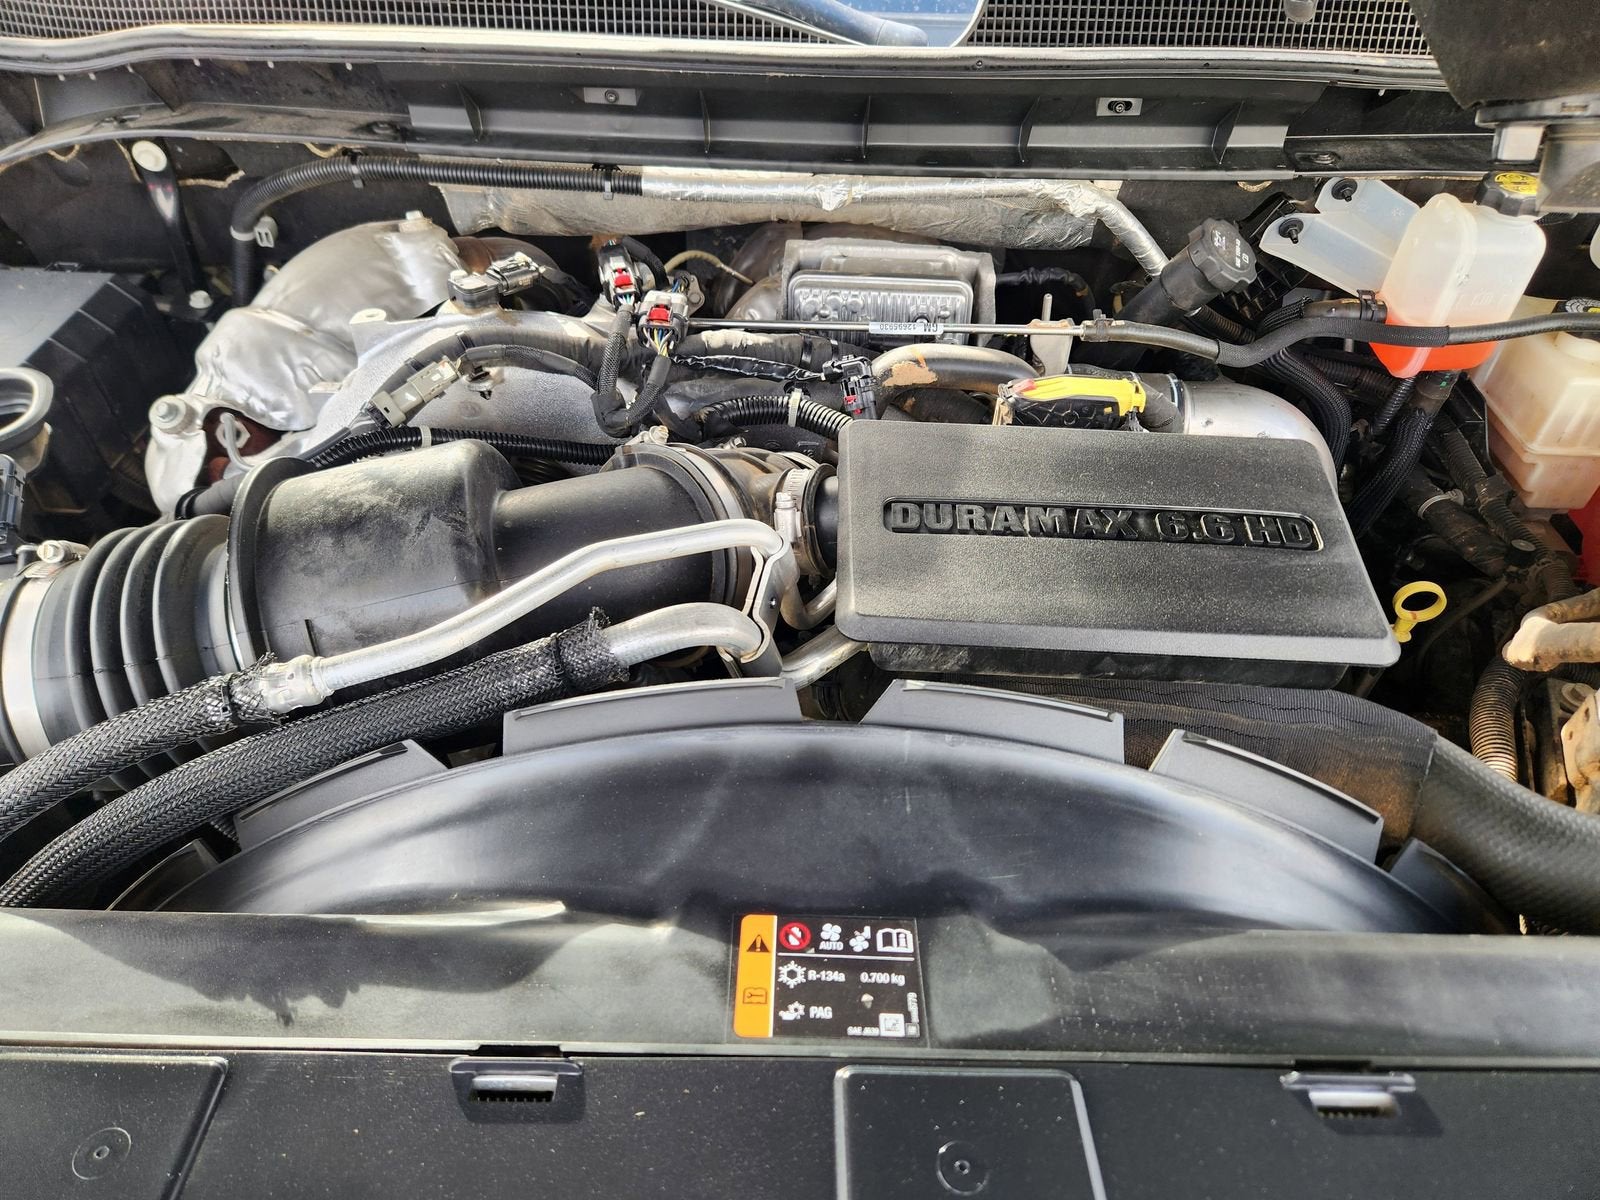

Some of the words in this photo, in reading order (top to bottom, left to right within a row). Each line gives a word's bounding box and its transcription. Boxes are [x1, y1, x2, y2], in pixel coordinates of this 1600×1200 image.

[923, 323, 938, 333] GM
[891, 502, 1139, 539] DURAMAX
[1155, 513, 1236, 543] 6.6
[1243, 515, 1314, 549] HD
[819, 941, 844, 951] AUTO
[807, 970, 846, 982] R-134a
[860, 971, 890, 984] 0.700
[890, 973, 905, 986] kg
[809, 1006, 833, 1019] PAG
